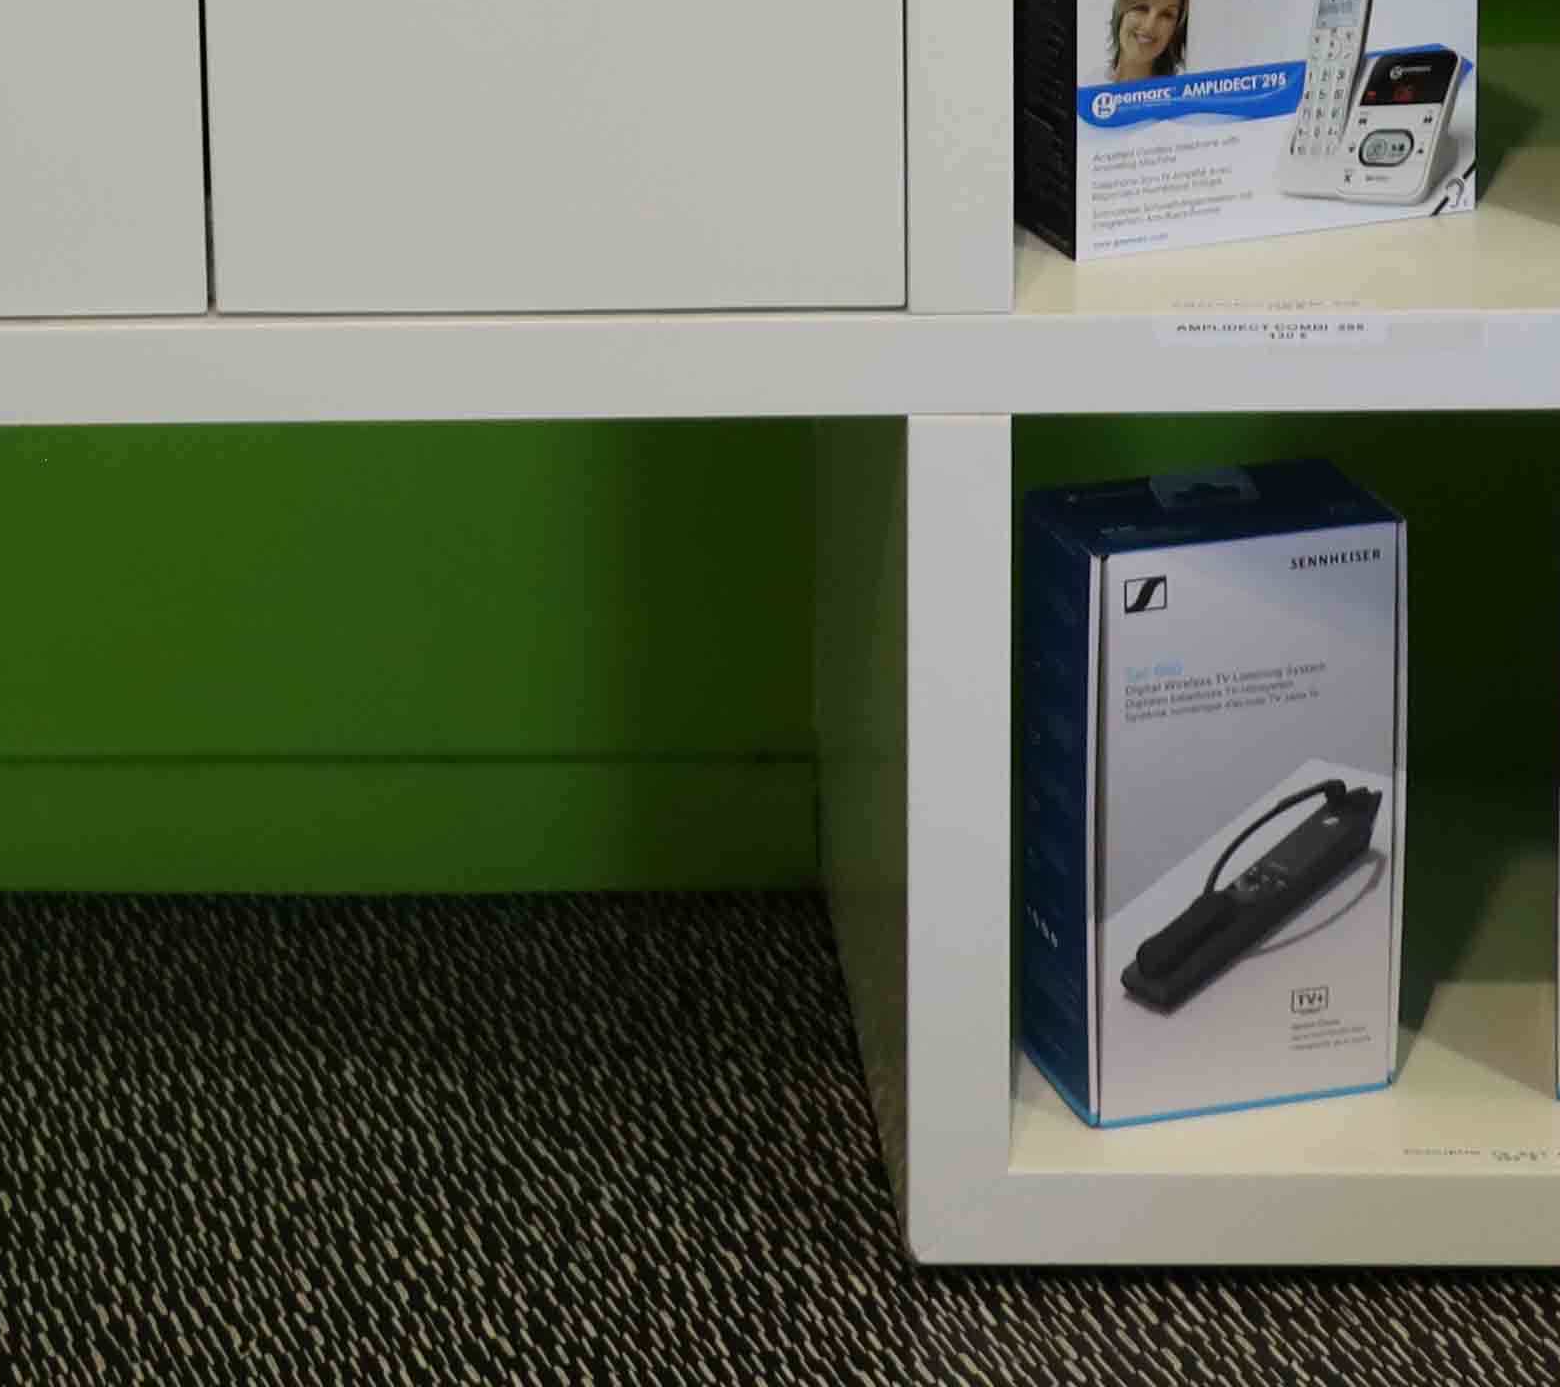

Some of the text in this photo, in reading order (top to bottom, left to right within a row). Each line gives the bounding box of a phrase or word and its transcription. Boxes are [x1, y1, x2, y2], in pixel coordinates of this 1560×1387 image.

[1183, 72, 1286, 98] AMPLIDECT 295
[1291, 549, 1381, 571] SENNHEISER
